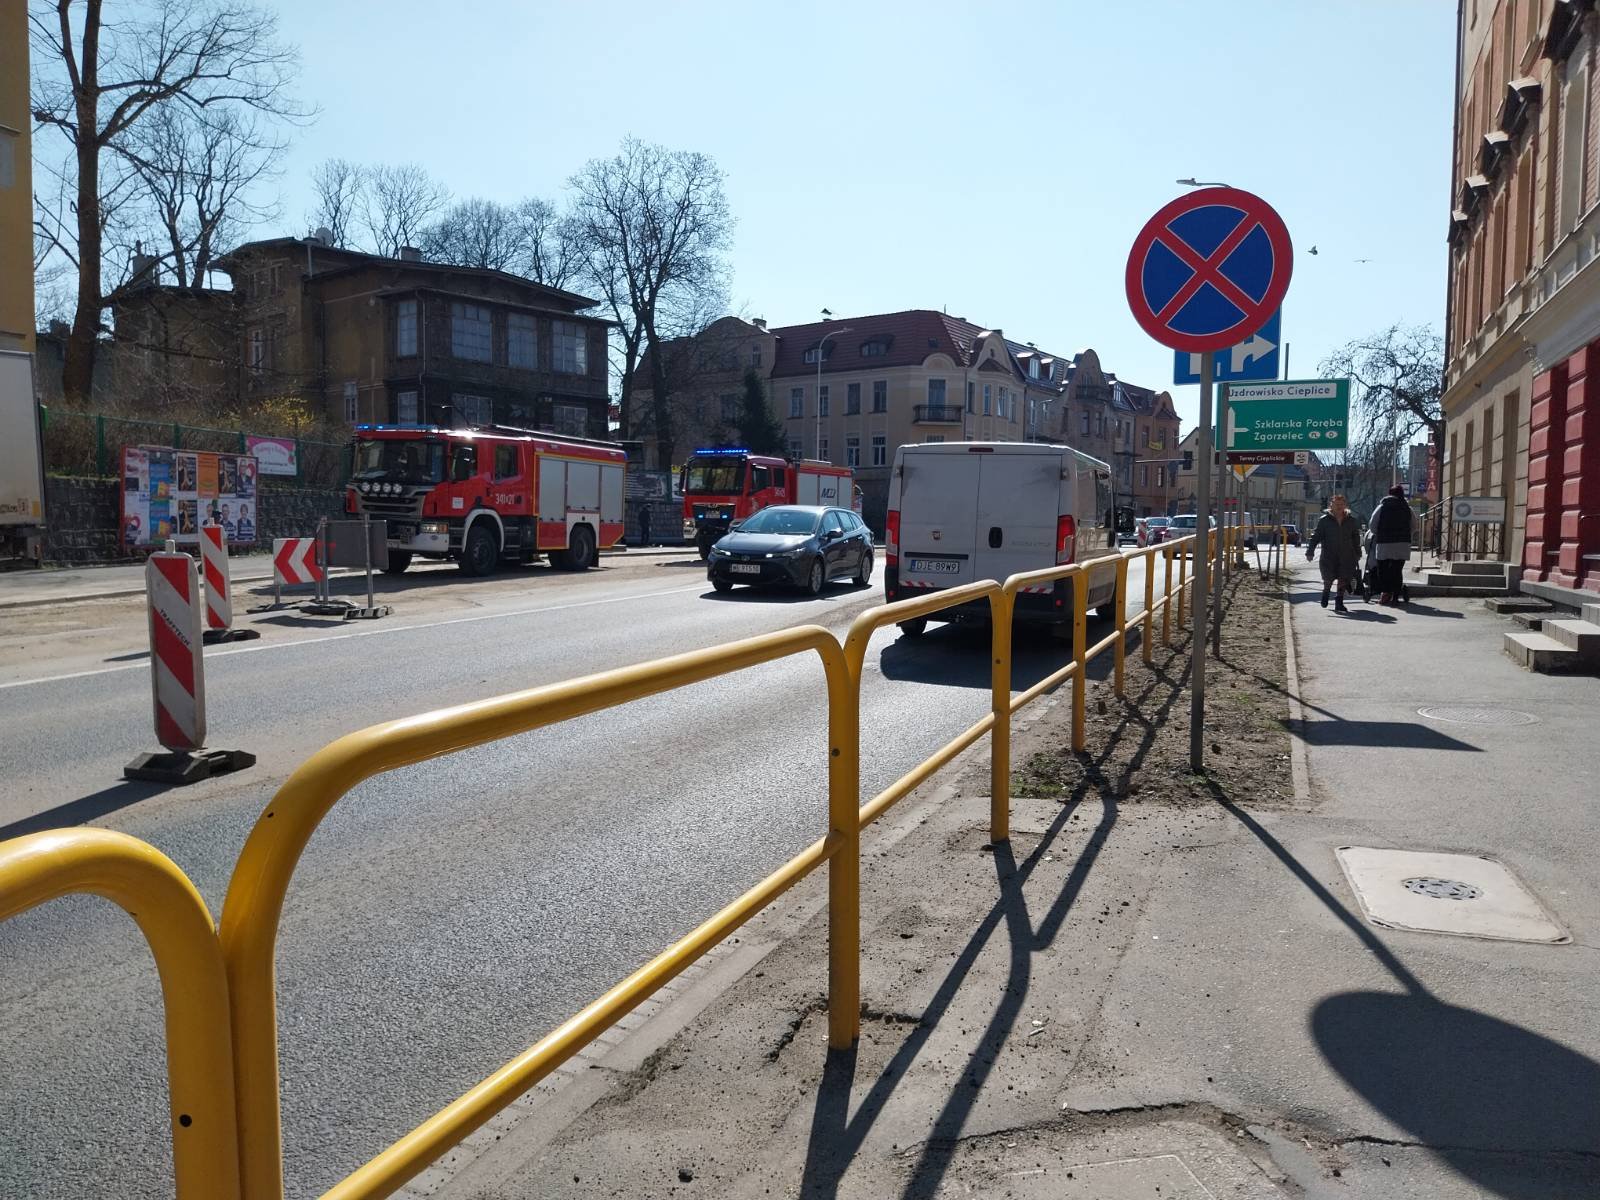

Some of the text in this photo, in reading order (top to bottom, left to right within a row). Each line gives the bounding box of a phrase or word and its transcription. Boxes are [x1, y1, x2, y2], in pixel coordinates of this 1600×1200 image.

[1287, 385, 1330, 397] Cieplice
[1255, 418, 1343, 429] Szklarska Poręba
[1254, 432, 1304, 442] Zgorzelec
[917, 561, 957, 571] DJE 89W9
